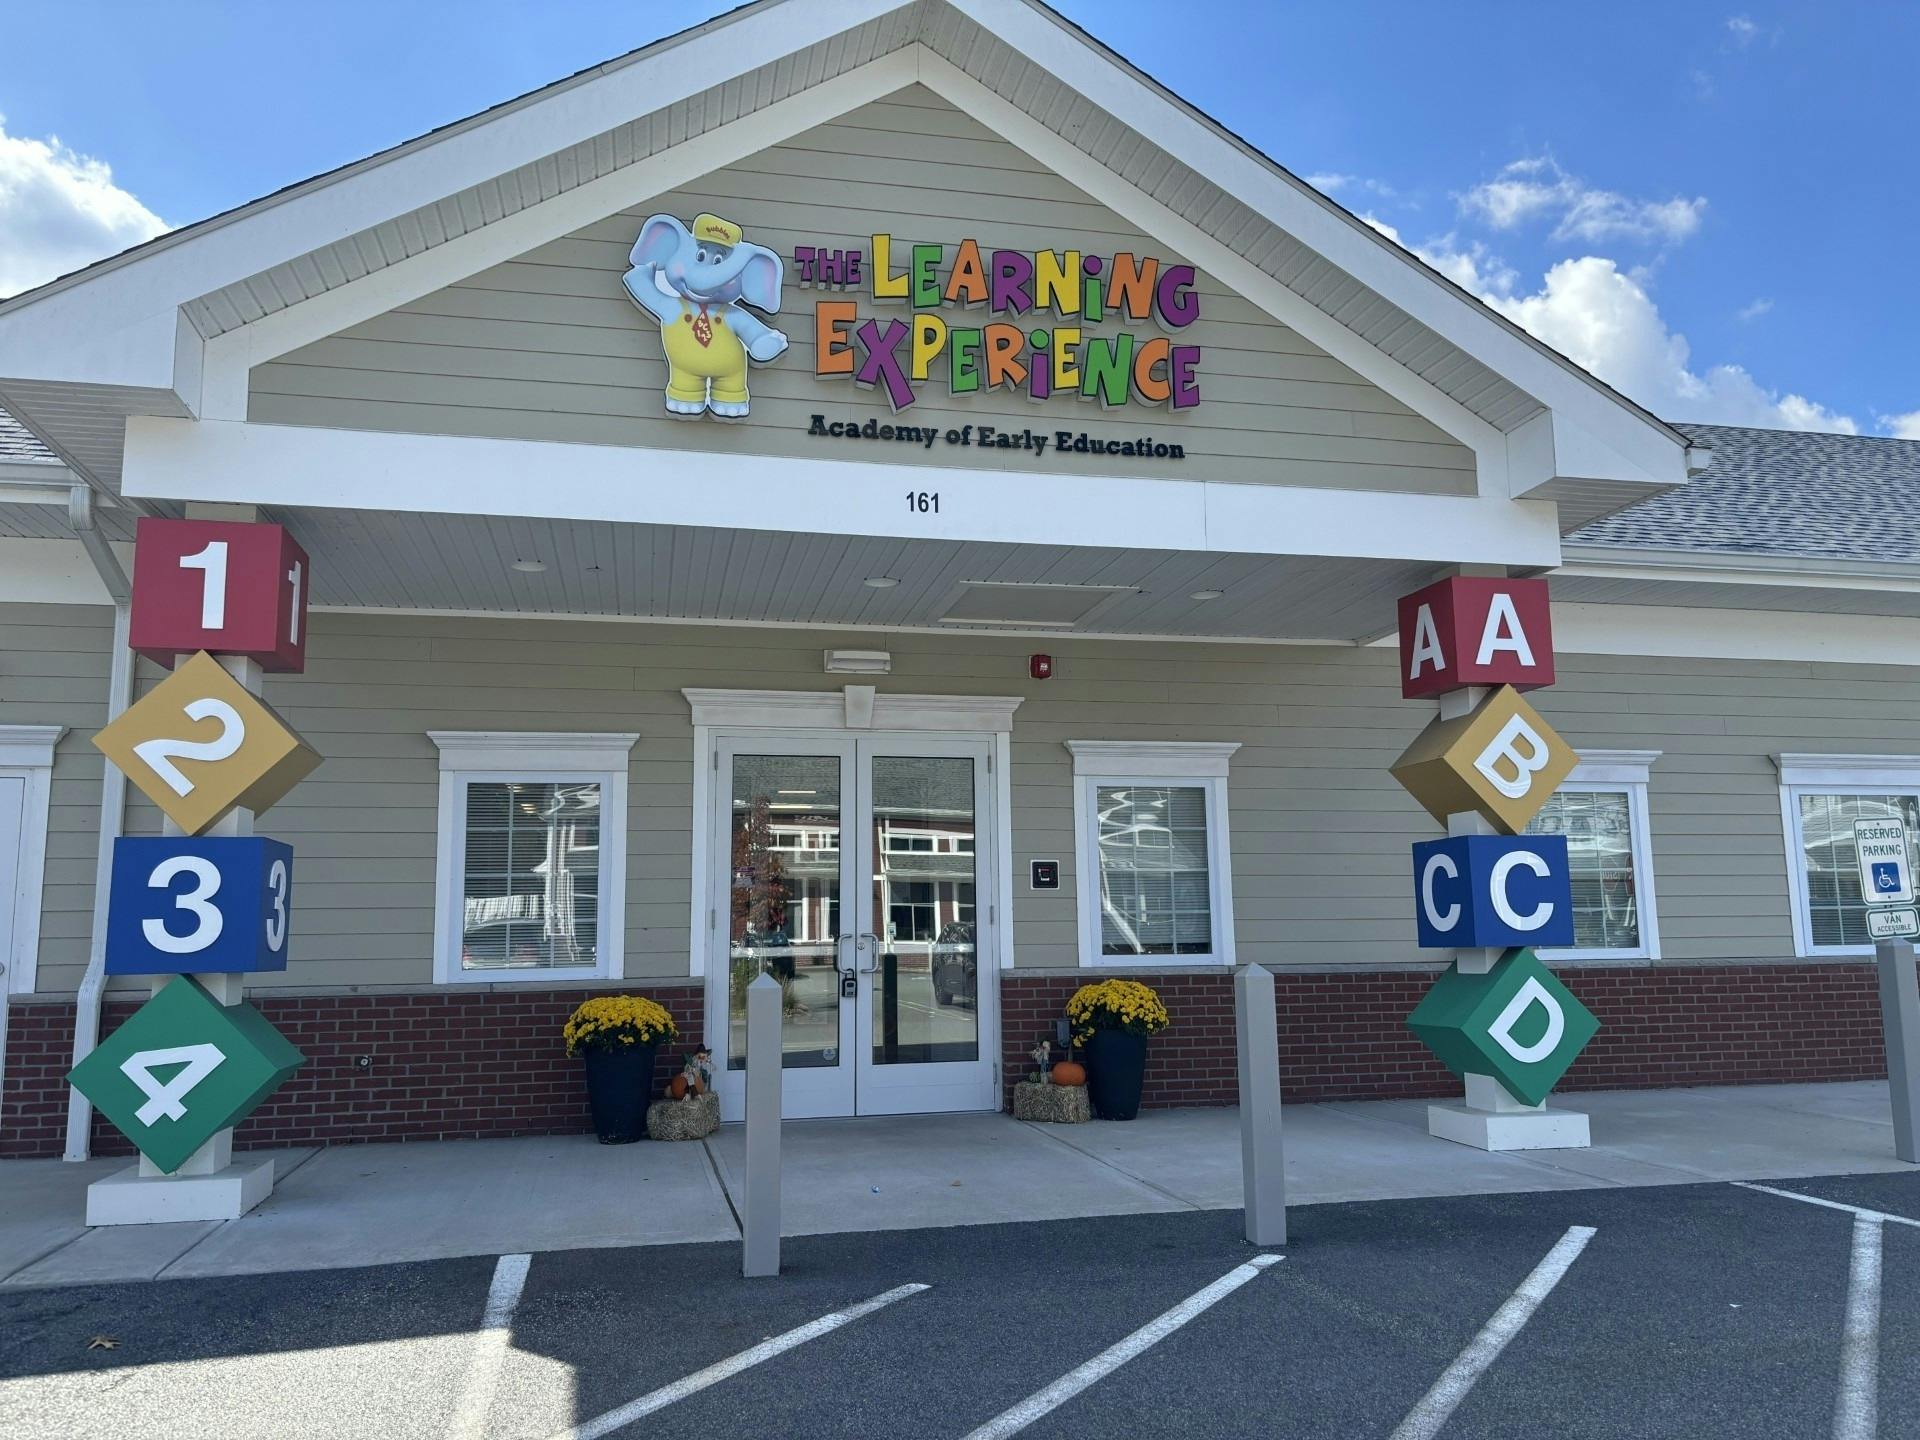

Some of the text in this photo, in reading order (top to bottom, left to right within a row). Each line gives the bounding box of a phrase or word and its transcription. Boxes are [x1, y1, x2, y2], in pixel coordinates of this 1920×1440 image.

[794, 245, 862, 287] THE
[807, 414, 1186, 459] Academy of Early Education
[905, 491, 941, 514] 161
[179, 541, 228, 630] 1
[287, 560, 301, 646] 1
[1409, 603, 1446, 681] A
[1475, 593, 1536, 666] A
[132, 697, 245, 798] 2
[1472, 712, 1550, 799] B
[1857, 827, 1902, 840] RESERVED
[1862, 844, 1902, 857] PARKING
[142, 855, 223, 954] 3
[265, 859, 287, 953] 3
[1422, 853, 1461, 932] C
[1489, 850, 1554, 932] C
[1877, 923, 1912, 933] ACCESSIBLE
[1884, 915, 1902, 924] VAN
[1487, 976, 1565, 1063] D
[119, 1043, 226, 1128] 4
